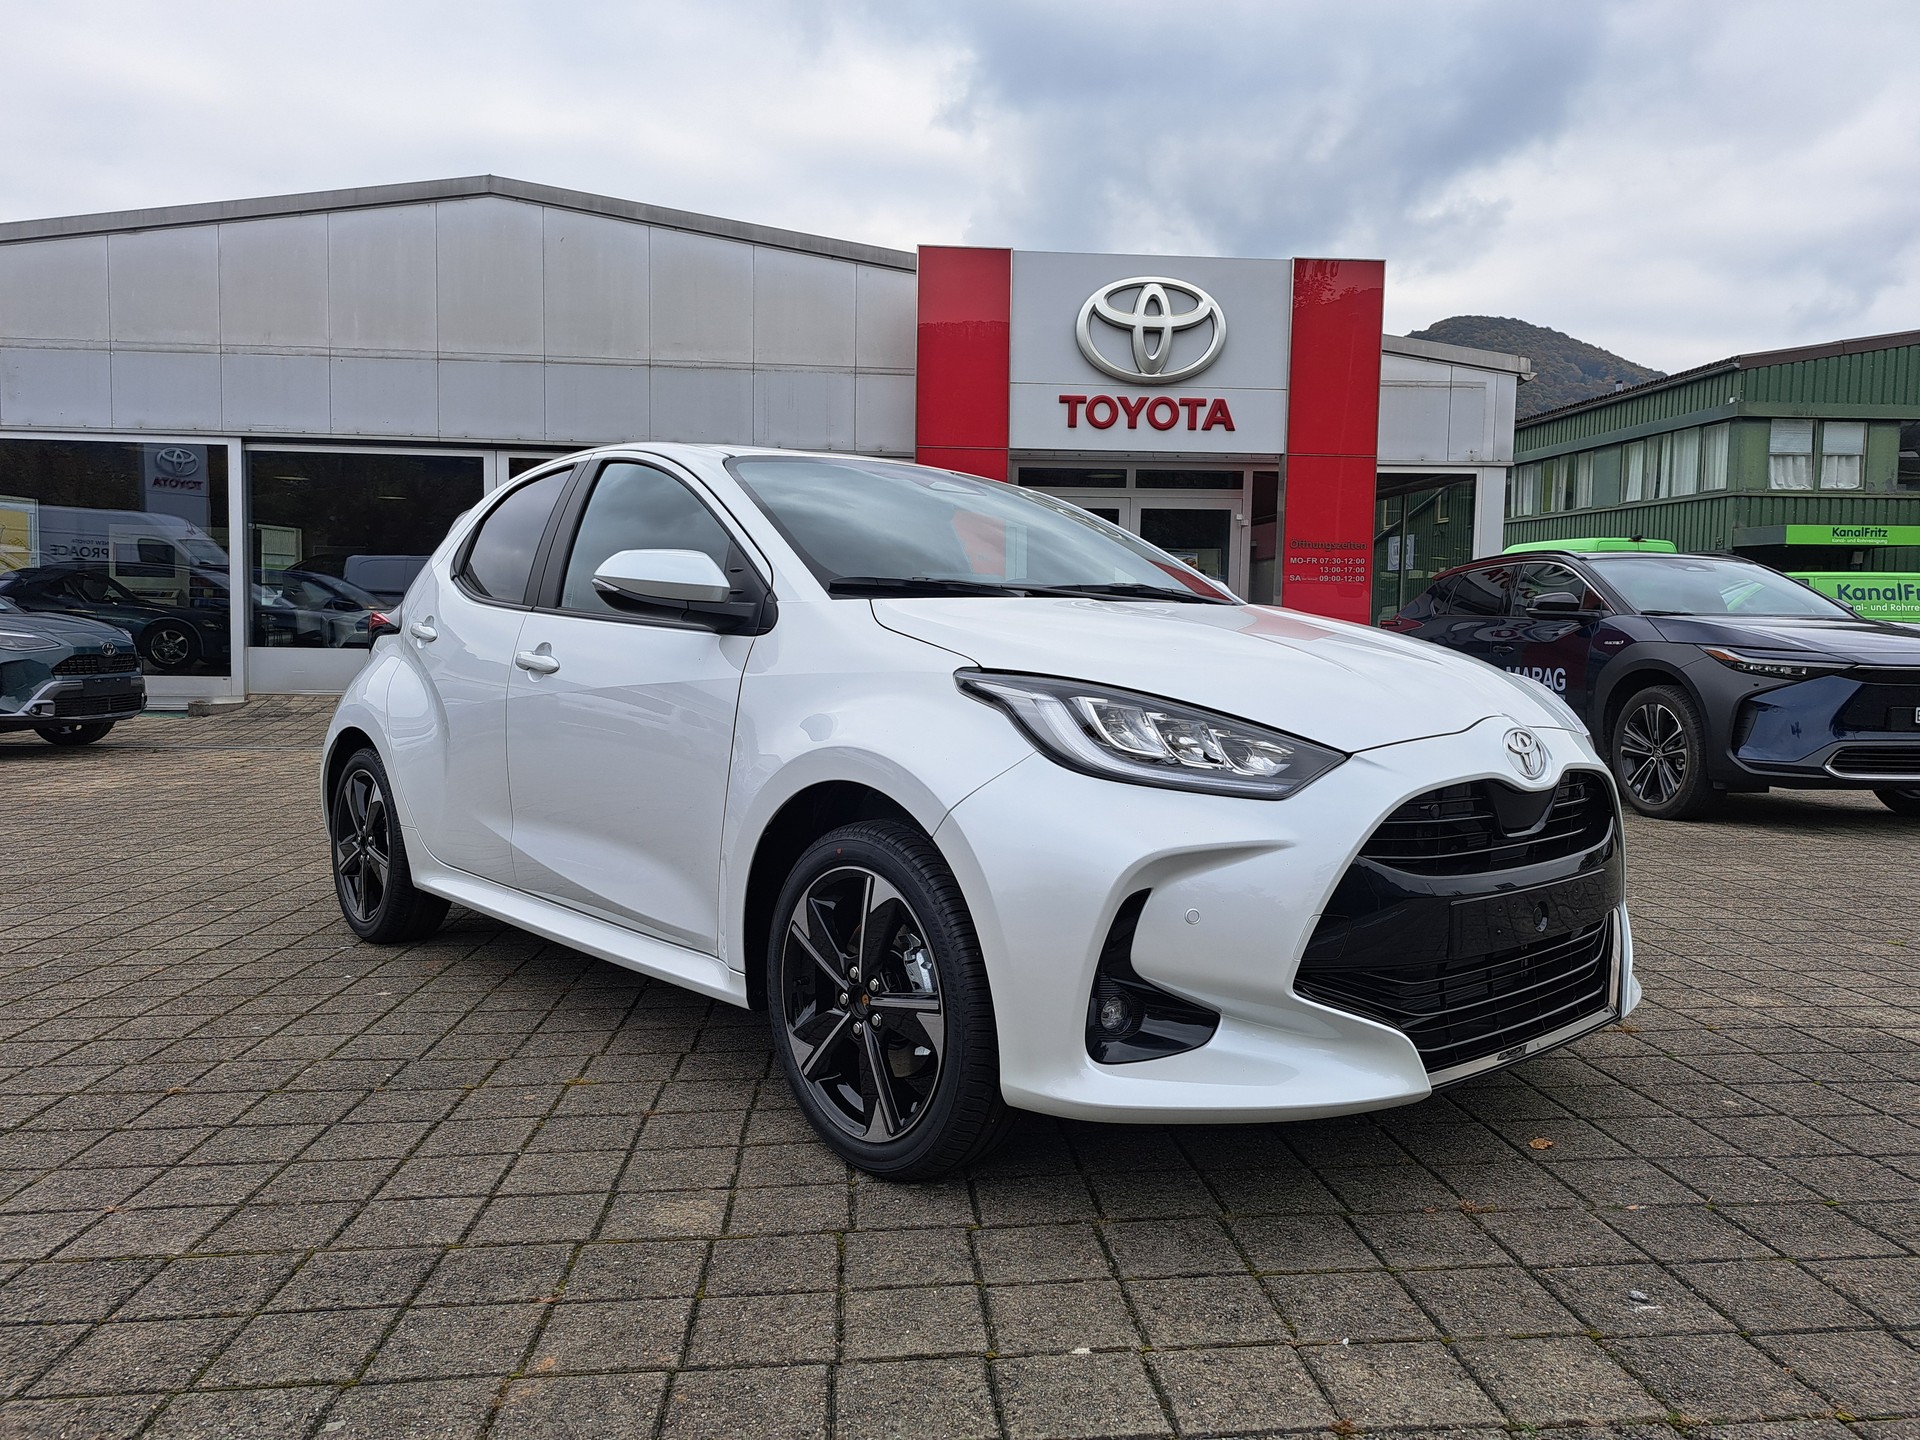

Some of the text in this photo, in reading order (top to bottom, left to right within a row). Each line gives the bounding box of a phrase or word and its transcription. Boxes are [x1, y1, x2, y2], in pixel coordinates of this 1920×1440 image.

[1058, 394, 1236, 432] TOYOTA
[1832, 527, 1888, 537] KanalFritz
[1290, 537, 1367, 552] Öffnungszeiten
[1319, 557, 1366, 565] 07:30-12:00
[1289, 574, 1302, 582] SA
[1852, 602, 1868, 612] al-
[1870, 603, 1888, 612] und
[1505, 666, 1566, 692] RAG
